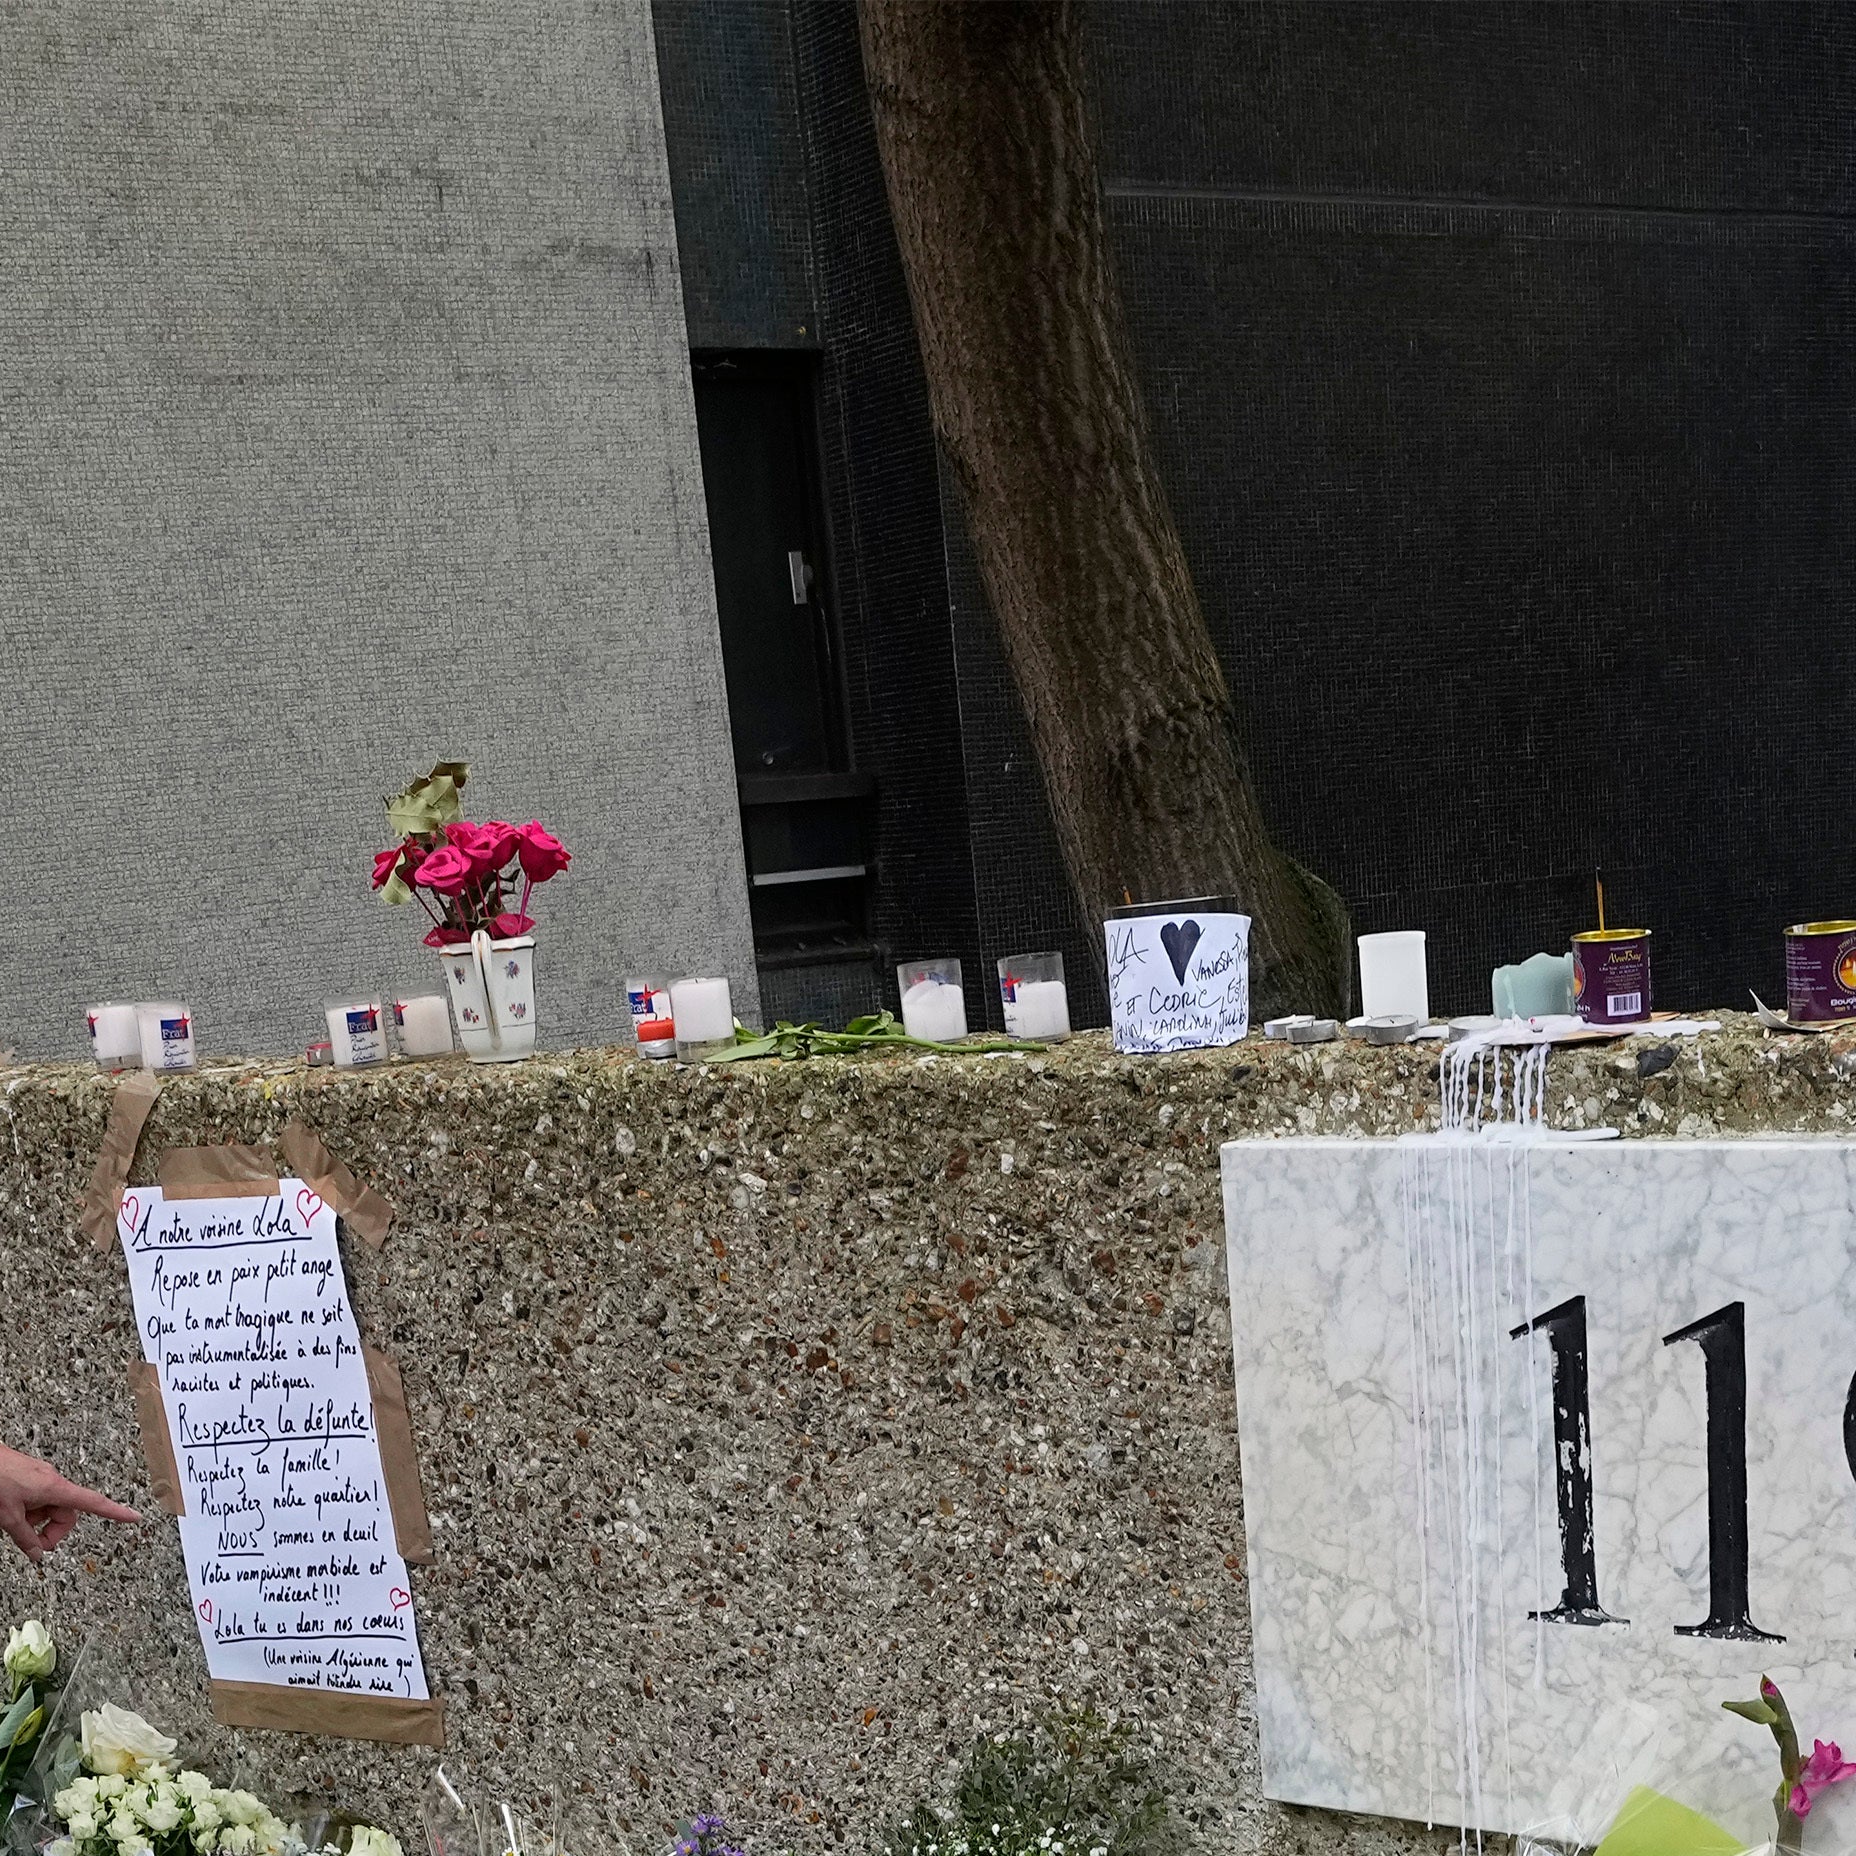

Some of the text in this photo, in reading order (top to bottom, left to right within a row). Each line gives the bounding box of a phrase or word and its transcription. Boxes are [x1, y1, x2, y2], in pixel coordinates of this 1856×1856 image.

[132, 1196, 298, 1246] A notre voisine Lola
[151, 1248, 334, 1310] Repose en paix petit ange
[148, 1298, 343, 1360] Que ta mort tragique ne soit
[166, 1335, 356, 1380] pas instrumentalisée à des fins
[172, 1368, 315, 1404] racistes et politiques.
[179, 1399, 376, 1464] Respectez la défunte!
[188, 1447, 340, 1498] Respectez la famille!
[200, 1478, 381, 1531] Respectez notre quartier!
[218, 1519, 378, 1551] NOUS sommes en deuil
[200, 1556, 388, 1594] Votre vampirisme morbide est
[215, 1608, 245, 1640] Lola
[254, 1612, 266, 1634] tu
[277, 1622, 286, 1634] es
[296, 1611, 324, 1633] dans
[334, 1619, 353, 1632] nos
[288, 1670, 320, 1686] aimait
[290, 1650, 322, 1664] voisine
[326, 1648, 389, 1676] Algérienne
[396, 1654, 414, 1678] qui
